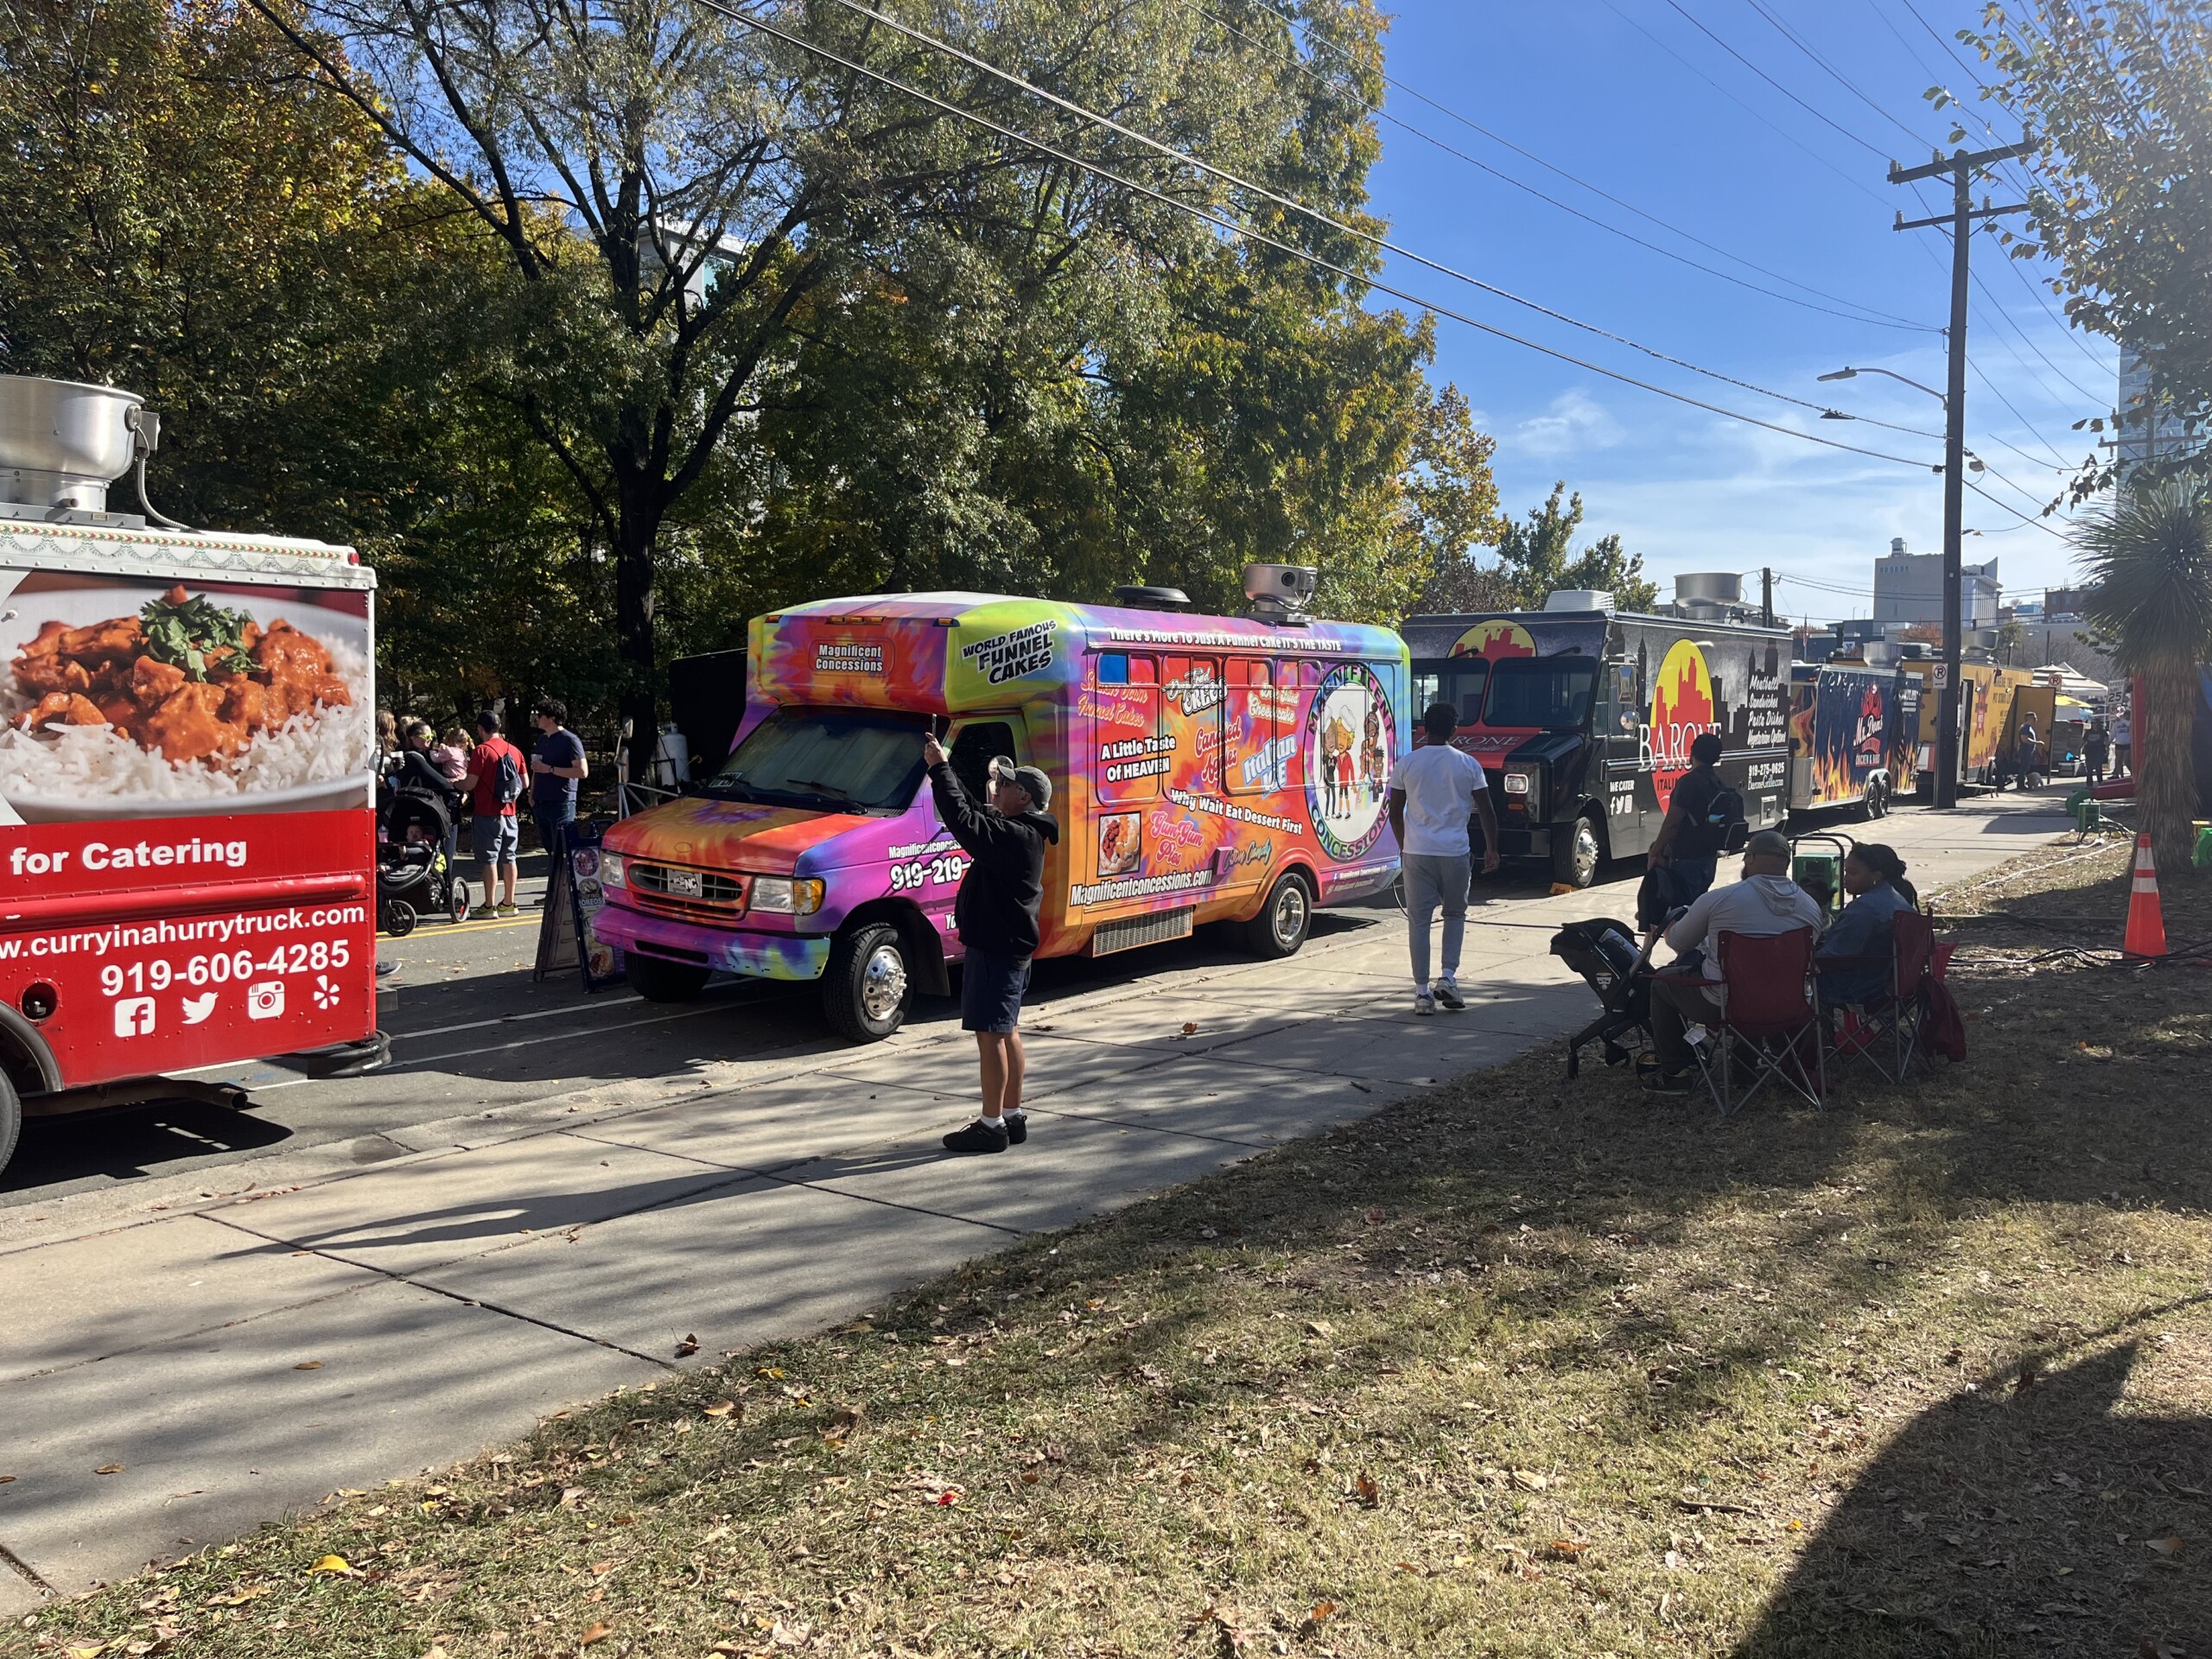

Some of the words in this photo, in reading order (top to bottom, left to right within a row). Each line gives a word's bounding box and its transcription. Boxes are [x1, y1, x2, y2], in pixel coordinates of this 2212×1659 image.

[818, 644, 882, 658] Magnificent
[963, 636, 1006, 657] WORLD
[1009, 620, 1056, 642] FAMOUS
[978, 632, 1053, 671] FUNNEL
[1109, 628, 1151, 642] There's
[1152, 630, 1179, 644] More
[1178, 631, 1193, 645] To
[1194, 632, 1217, 645] Just
[1217, 633, 1226, 645] A
[1227, 635, 1259, 646] Funnel
[1260, 636, 1281, 648] Cake
[1299, 639, 1317, 651] THE
[1317, 639, 1342, 652] TASTE
[815, 658, 883, 672] Concessions
[989, 650, 1052, 683] CAKES
[1307, 664, 1395, 734] MAGNIFICENT
[2108, 692, 2122, 702] 25
[1115, 701, 1145, 728] Cakes
[1101, 744, 1111, 760] A
[1112, 739, 1144, 759] Little
[1144, 735, 1176, 753] Taste
[1242, 733, 1298, 787] Italian
[1106, 764, 1122, 782] Of
[1122, 756, 1170, 779] HEAVEN
[1748, 761, 1785, 777] 919-275-0625
[1610, 781, 1618, 792] WE
[1618, 779, 1635, 791] CATER
[1171, 788, 1197, 811] Why
[1198, 796, 1224, 816] Wait
[1225, 803, 1243, 820] Eat
[1243, 807, 1281, 830] Dessert
[1281, 817, 1303, 836] First
[1311, 797, 1389, 860] CONCESSIONS
[10, 847, 68, 875] for
[83, 837, 247, 870] Catering
[1156, 839, 1183, 867] Pies
[1245, 837, 1272, 866] Candy
[1071, 869, 1213, 906] Magnificentconcessions.com
[581, 898, 603, 906] OREOS
[100, 939, 351, 997] 919-606-4285
